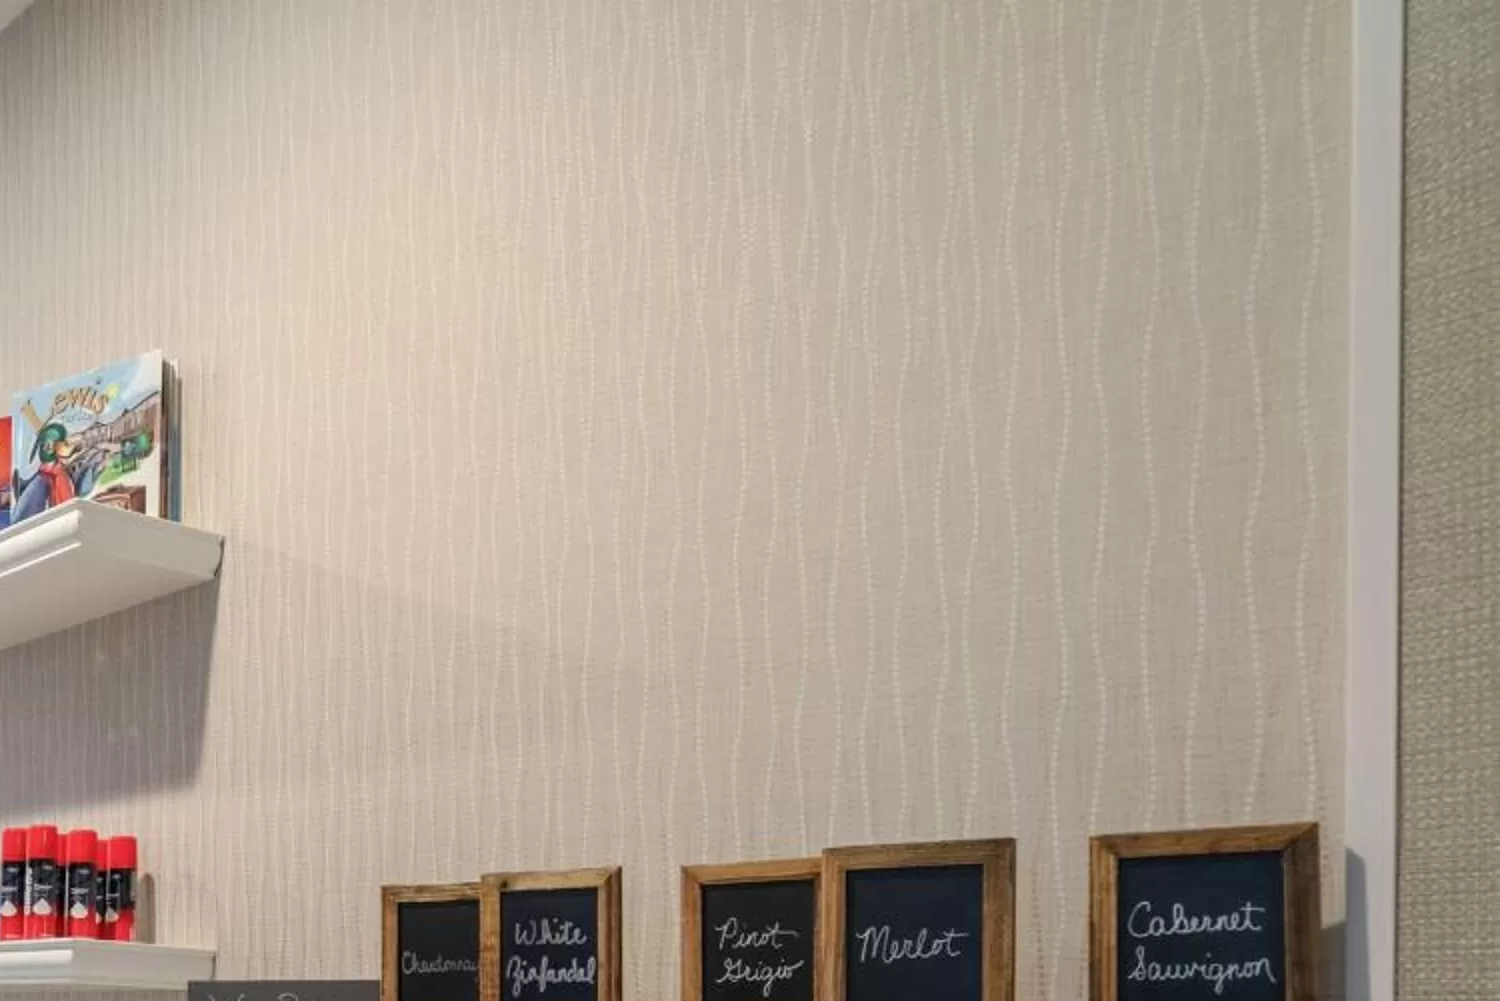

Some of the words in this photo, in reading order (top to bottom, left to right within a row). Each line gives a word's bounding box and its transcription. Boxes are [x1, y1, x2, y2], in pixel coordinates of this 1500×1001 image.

[515, 917, 587, 945] White
[714, 917, 798, 950] Pinot
[1128, 901, 1266, 938] Cabernet
[856, 925, 969, 964] Merlot
[506, 955, 597, 998] Zinfandel
[716, 957, 804, 998] Grigio
[1128, 945, 1277, 996] Sauvignon
